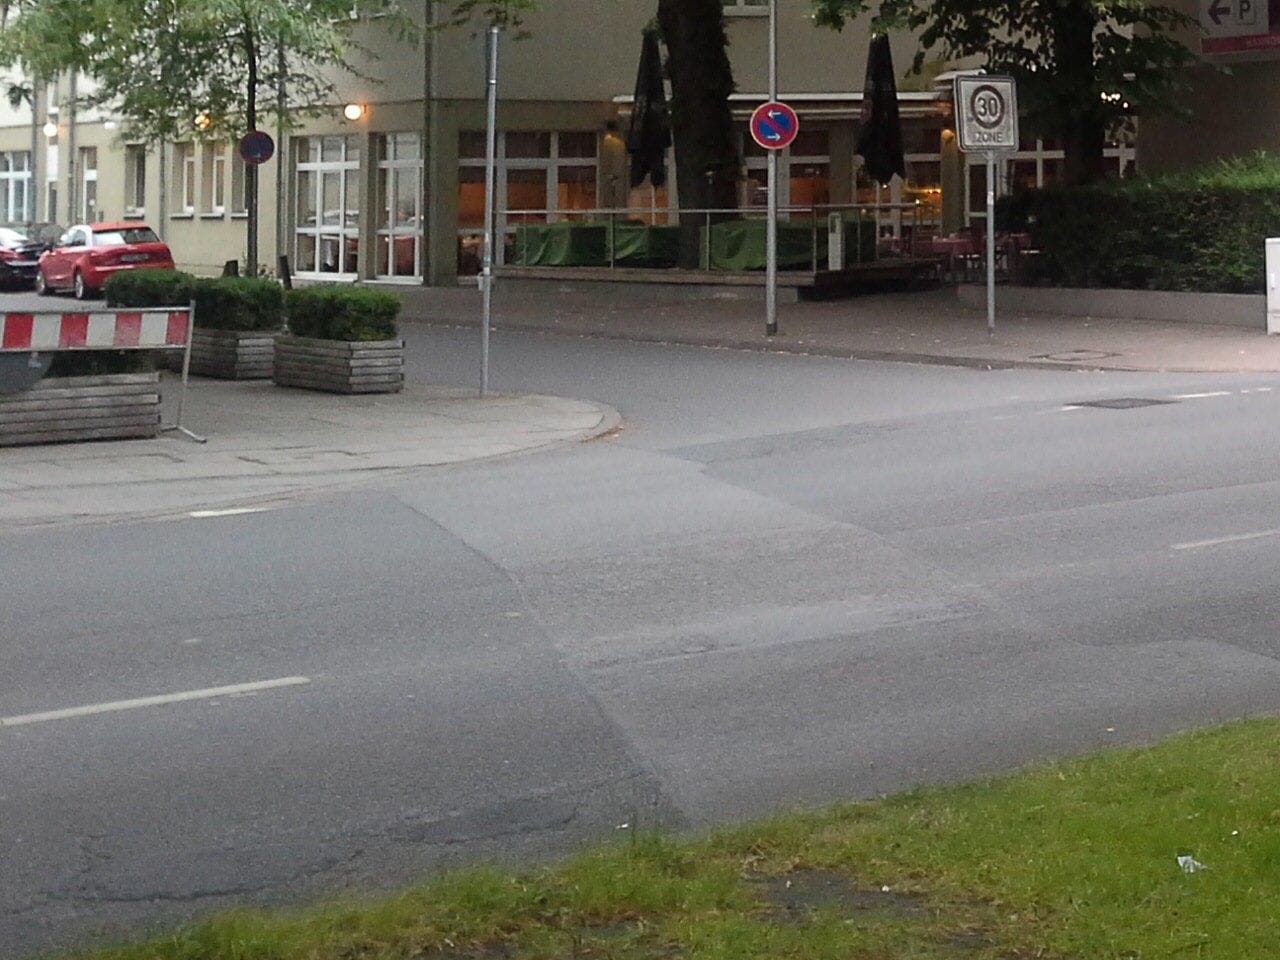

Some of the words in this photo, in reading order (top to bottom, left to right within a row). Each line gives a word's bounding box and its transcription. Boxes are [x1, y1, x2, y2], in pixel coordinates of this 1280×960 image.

[1240, 0, 1251, 20] P
[977, 97, 998, 117] 30
[974, 131, 1003, 143] ZONE
